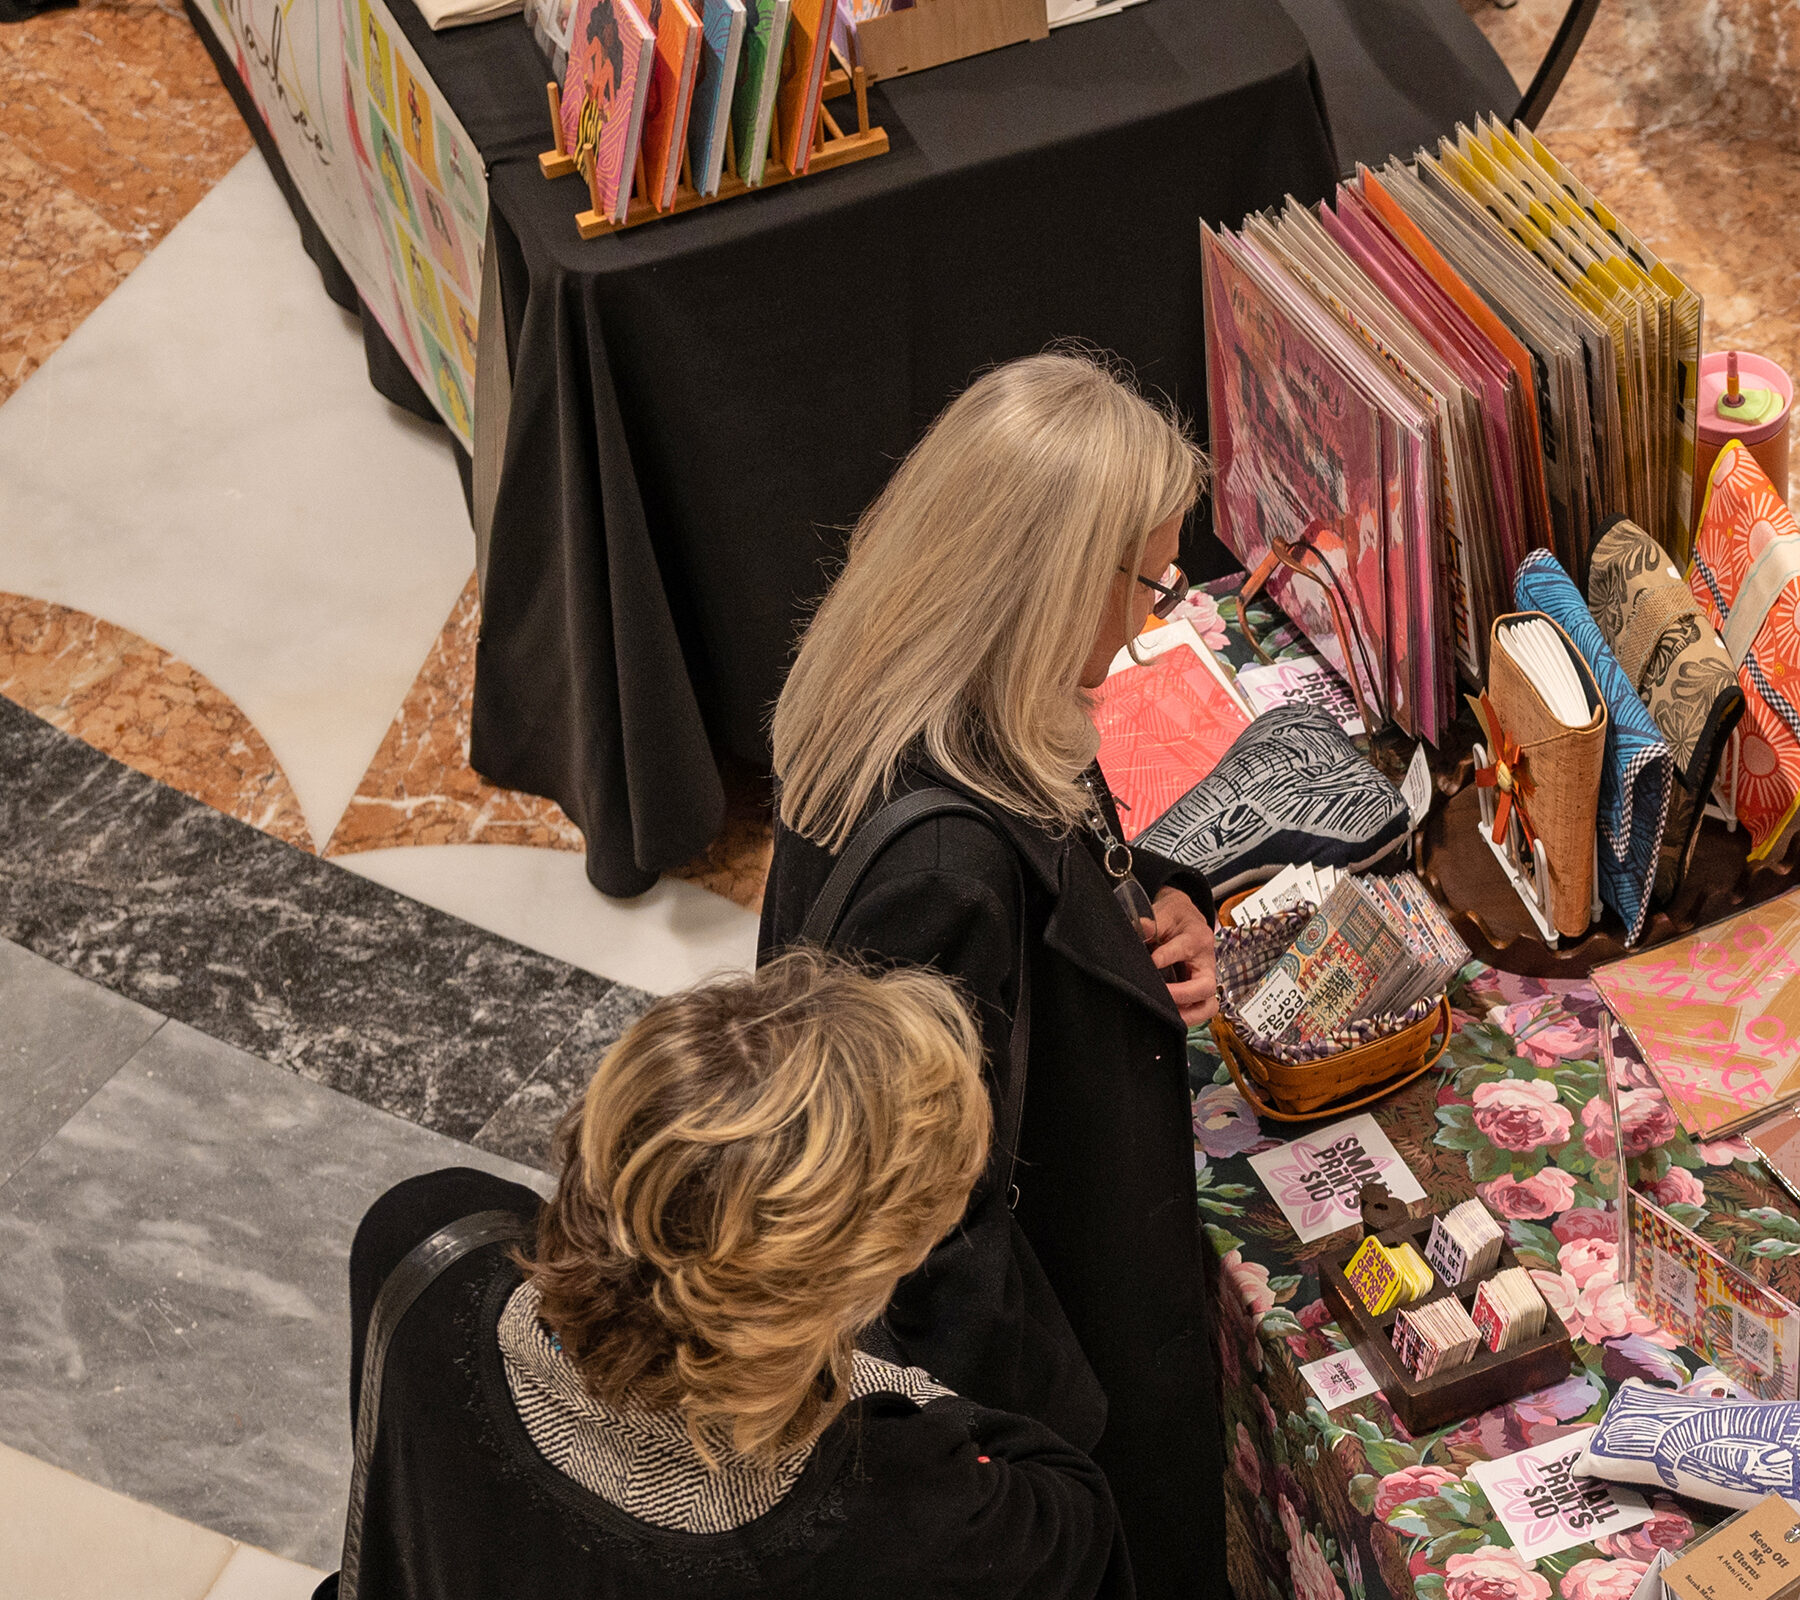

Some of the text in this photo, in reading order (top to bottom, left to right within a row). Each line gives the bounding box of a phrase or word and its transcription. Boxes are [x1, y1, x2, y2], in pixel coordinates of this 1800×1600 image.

[1733, 924, 1800, 982] GET
[1688, 941, 1762, 1007] OUT
[1257, 988, 1297, 1033] cards
[1640, 959, 1774, 1111] MY FACE
[1300, 1171, 1335, 1202] $10
[1433, 1239, 1460, 1273] ALL GET
[1437, 1224, 1462, 1258] CAN WE
[1366, 1241, 1396, 1281] FAILURE
[1430, 1255, 1457, 1285] ALONG?
[1352, 1268, 1378, 1305] LEARN
[1331, 1374, 1342, 1384] $2
[1334, 1363, 1357, 1391] STICKERS
[1524, 1485, 1559, 1519] $10
[1732, 1549, 1761, 1581] Uterus
[1749, 1529, 1790, 1569] Keep Off
[1749, 1548, 1766, 1566] My
[1685, 1574, 1701, 1591] Sarah
[1707, 1585, 1716, 1595] by
[1722, 1560, 1754, 1592] Manifesto
